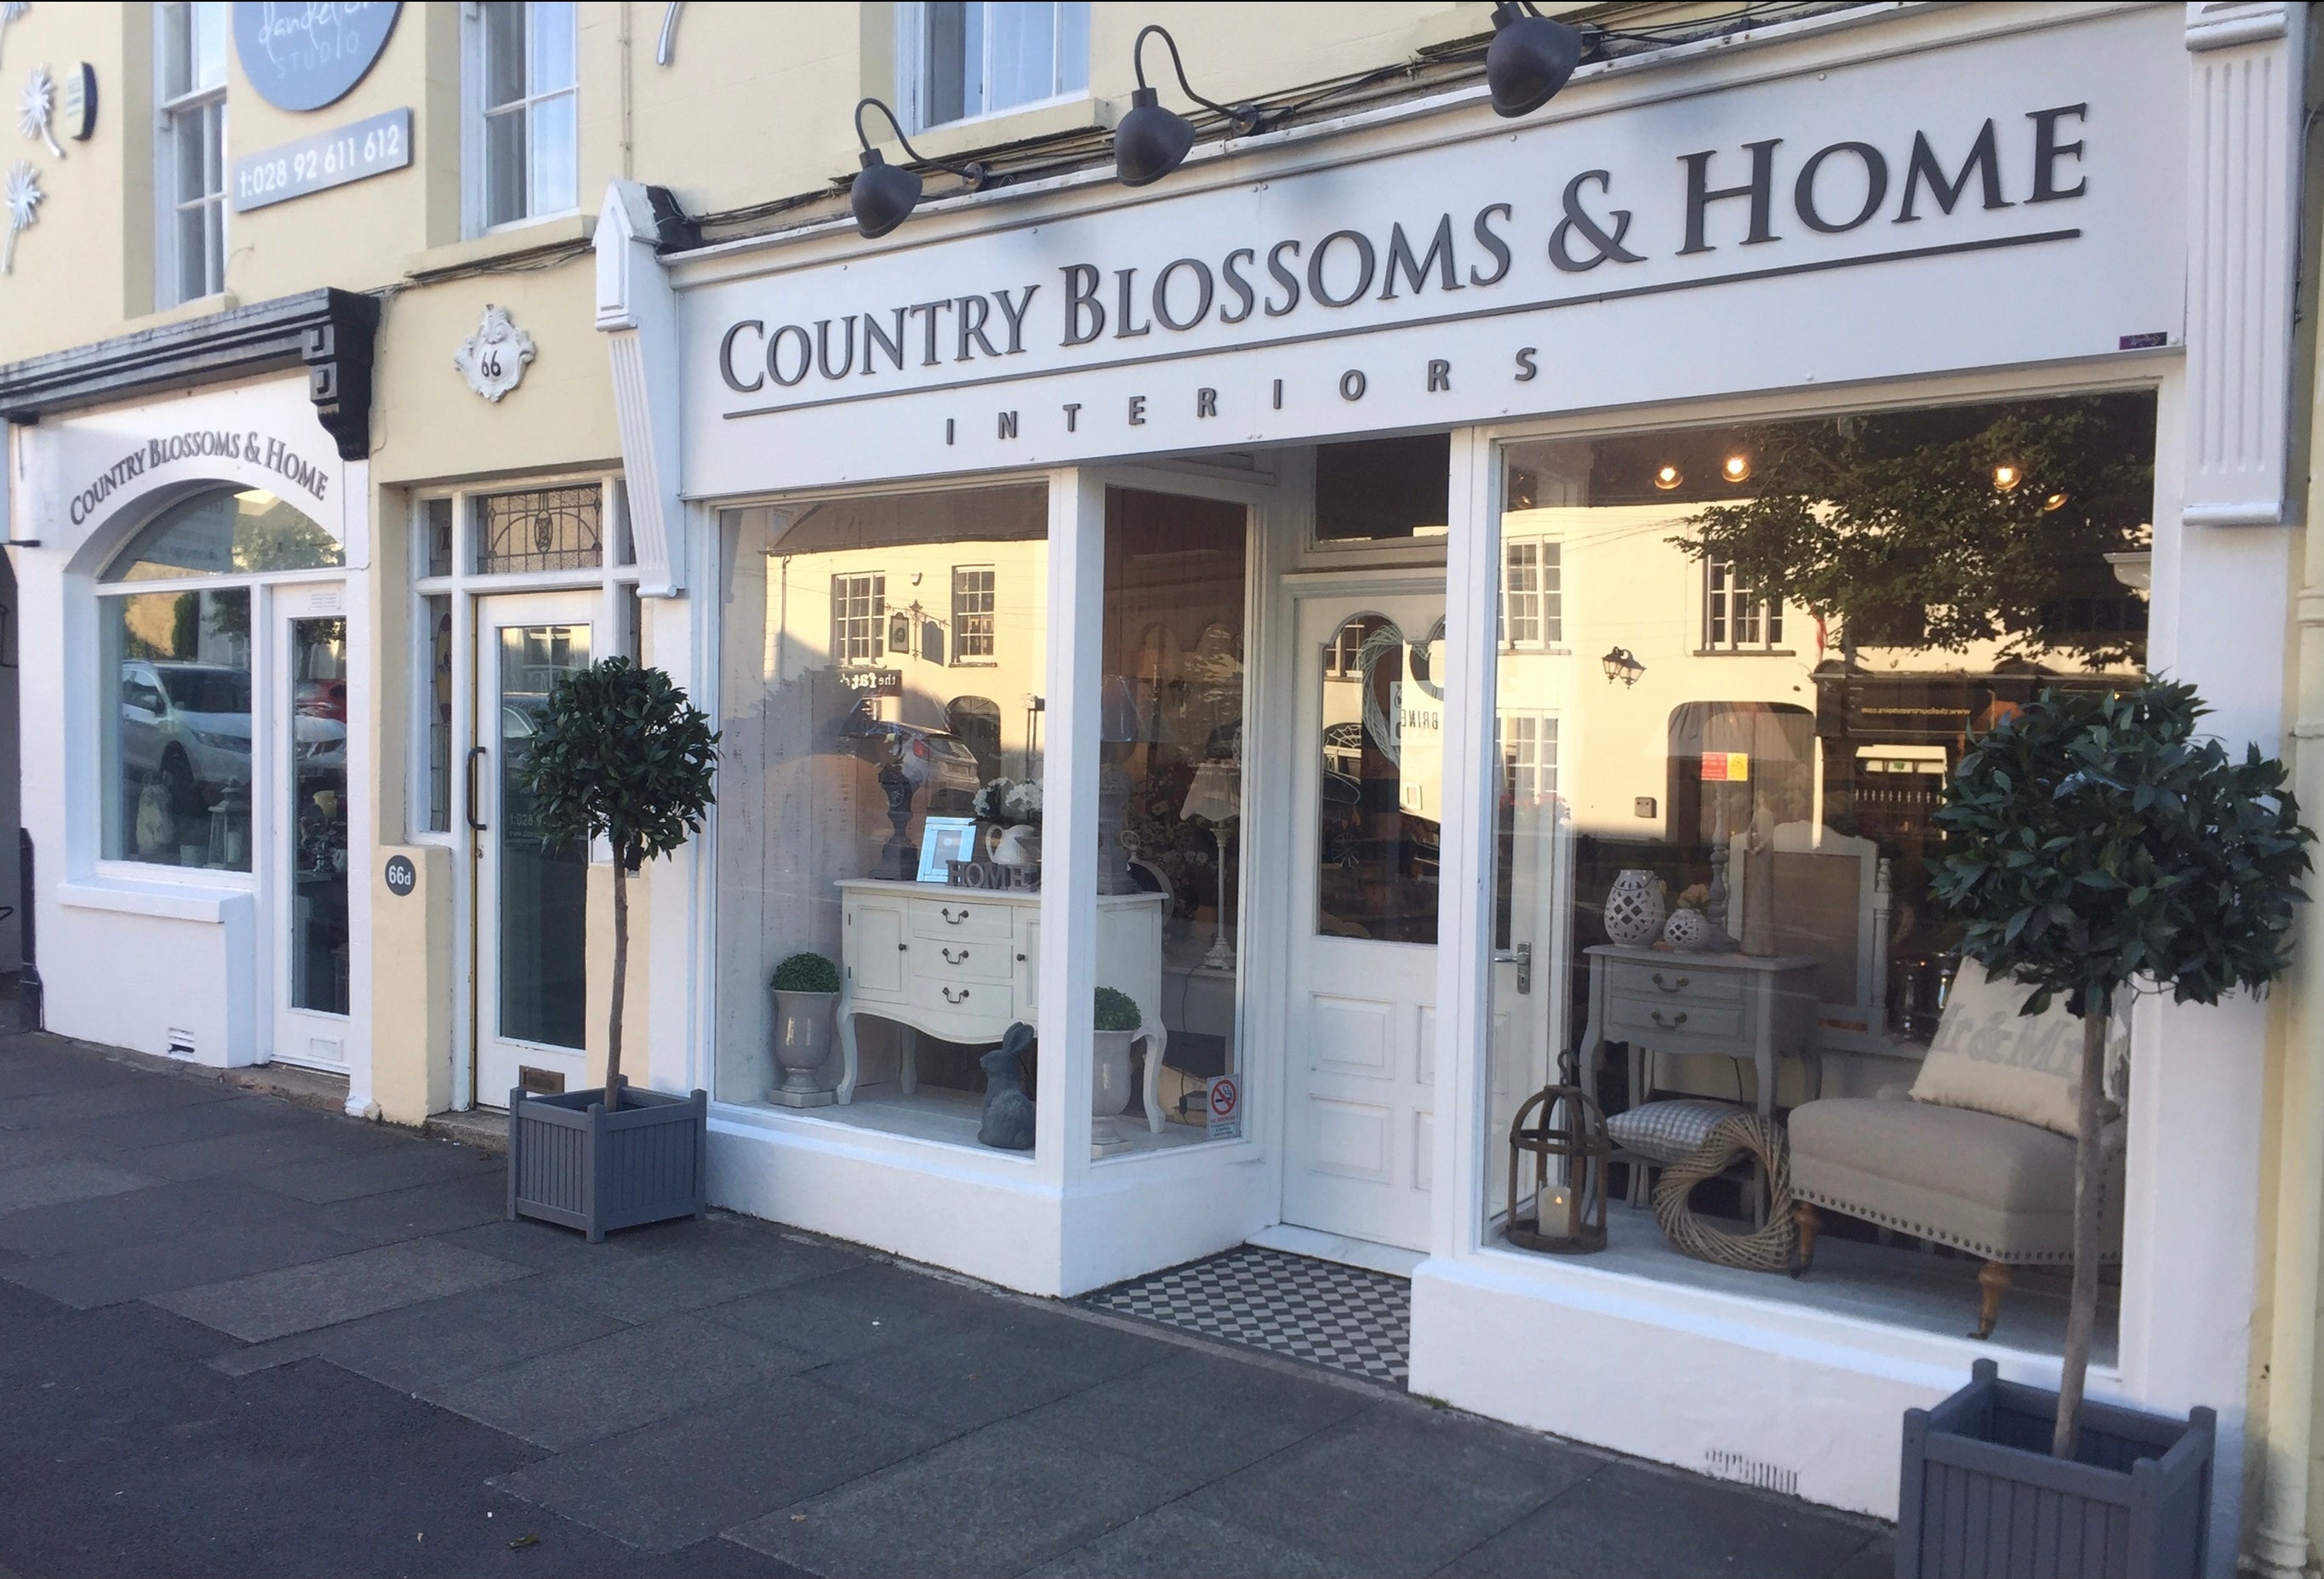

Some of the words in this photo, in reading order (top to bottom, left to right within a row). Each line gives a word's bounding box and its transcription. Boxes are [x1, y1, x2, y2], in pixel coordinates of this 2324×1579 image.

[276, 31, 359, 79] STUDIO
[240, 158, 287, 197] t:028
[294, 149, 318, 182] 92
[324, 137, 355, 174] 611
[363, 124, 399, 163] 612
[719, 284, 1042, 393] COUNTRY
[1058, 203, 1512, 347] BLOSSOMS
[1548, 169, 1649, 274] &
[1674, 101, 2089, 256] HOME
[481, 350, 501, 377] 66
[945, 346, 1538, 446] INTERIORS
[70, 448, 147, 526] COUNTRY
[147, 431, 241, 469] BLOSSOMS
[243, 431, 261, 464] &
[265, 436, 328, 501] HOME
[389, 866, 411, 885] 66d
[946, 860, 1031, 892] HOME
